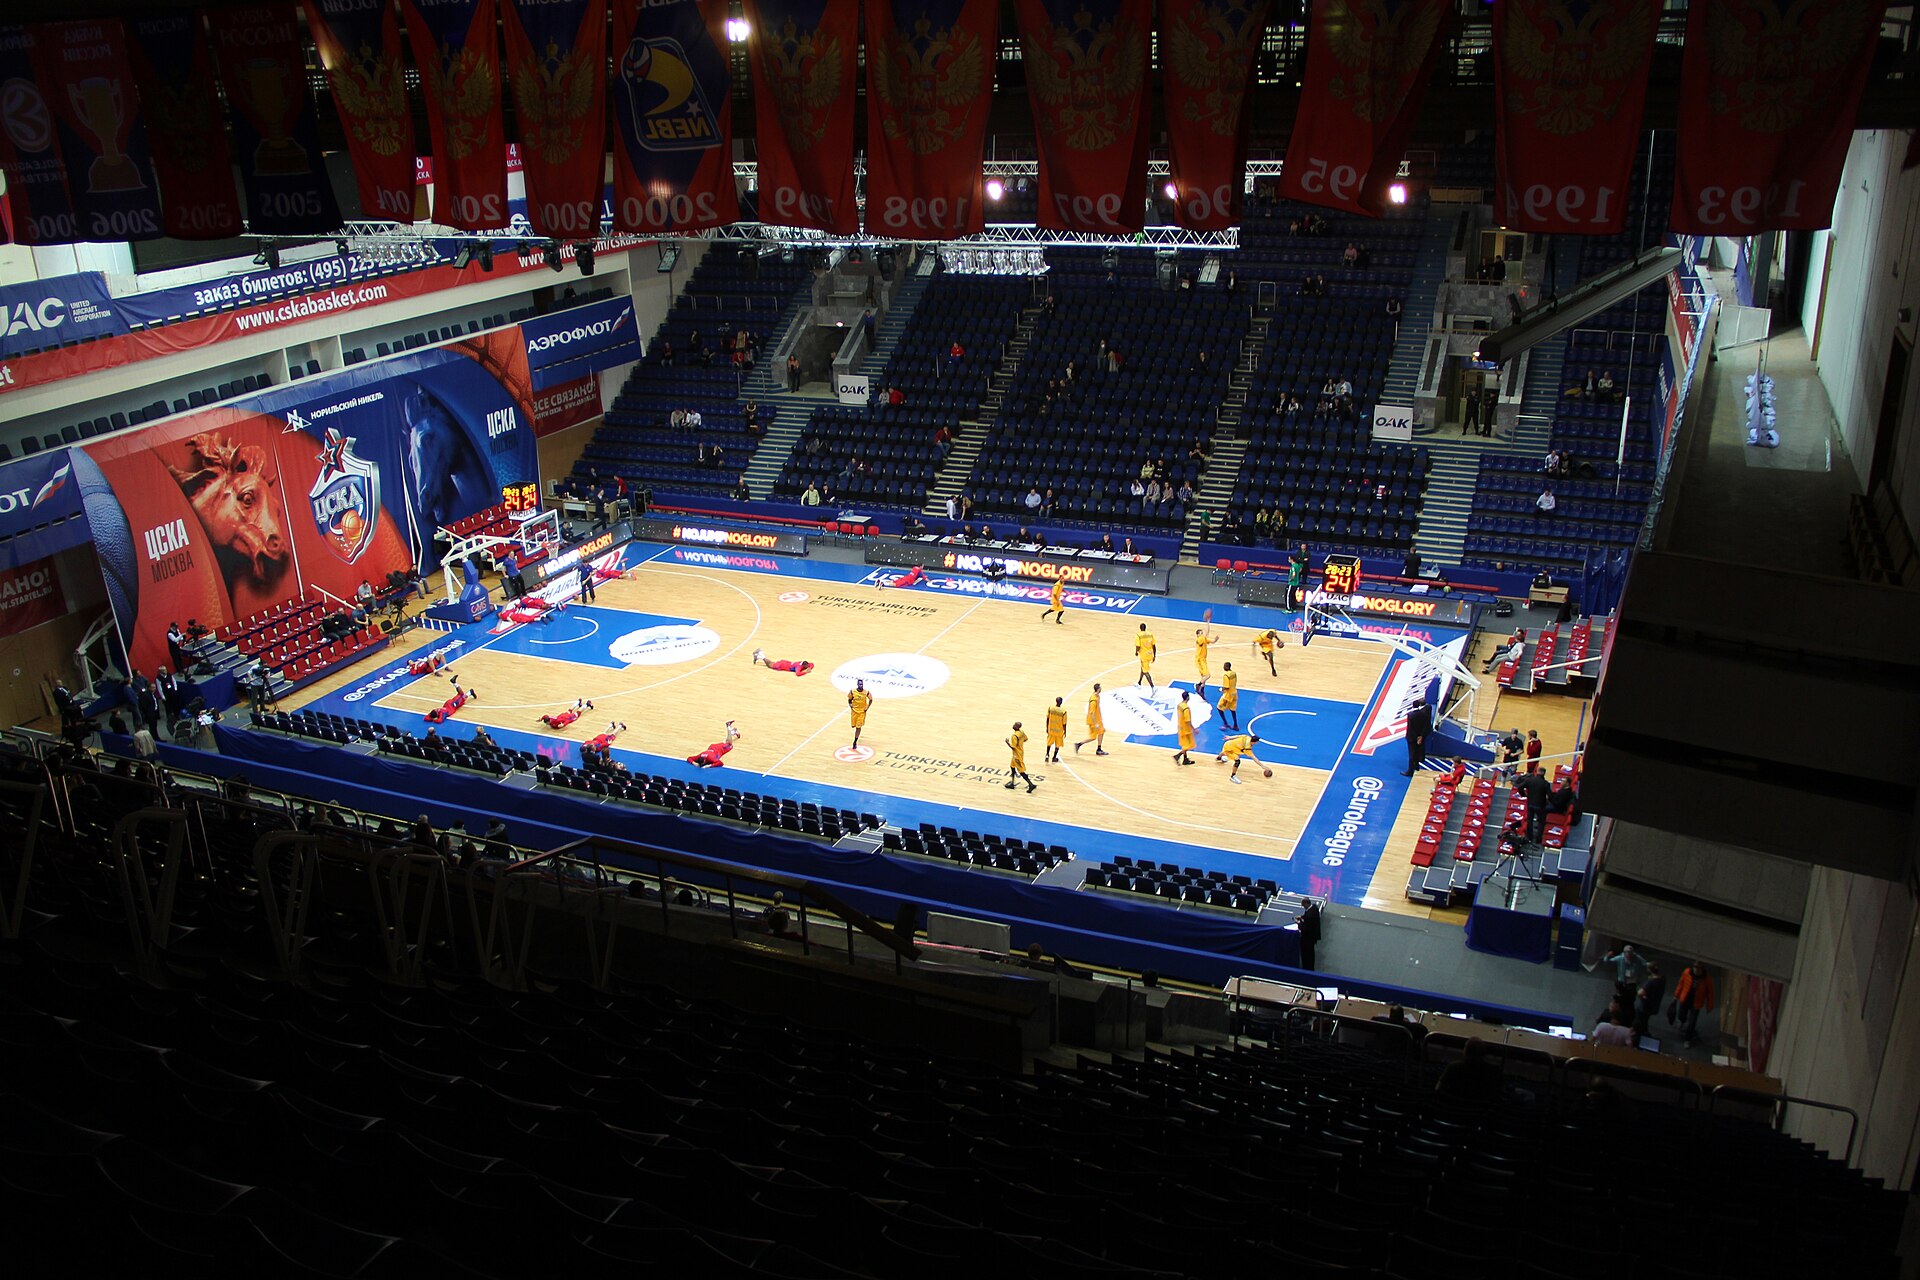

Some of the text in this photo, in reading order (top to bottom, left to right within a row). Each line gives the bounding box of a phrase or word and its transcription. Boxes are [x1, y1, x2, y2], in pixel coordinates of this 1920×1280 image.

[416, 171, 430, 180] СКА
[194, 284, 241, 306] заказ
[242, 268, 308, 295] билетов:
[309, 259, 347, 283] (495)
[74, 310, 111, 323] CORPORATION
[236, 284, 387, 330] www.cskabasket.com
[527, 319, 611, 354] АЭРОФЛОТ
[310, 392, 384, 420] НОРИЛЬСКИЙ НИКЕЛЬ
[486, 406, 516, 439] ЦСКА
[313, 482, 364, 525] ЦСКА
[504, 496, 520, 510] 24
[524, 492, 537, 510] 24
[144, 518, 190, 561] ЦСКА
[151, 550, 194, 584] МОСКВА
[1325, 575, 1351, 592] 24
[808, 600, 932, 618] EUROLEAGUE
[817, 595, 939, 613] TURKISH AIRLINES
[885, 751, 961, 769] TURKISH
[1322, 776, 1384, 867] @Euroleague
